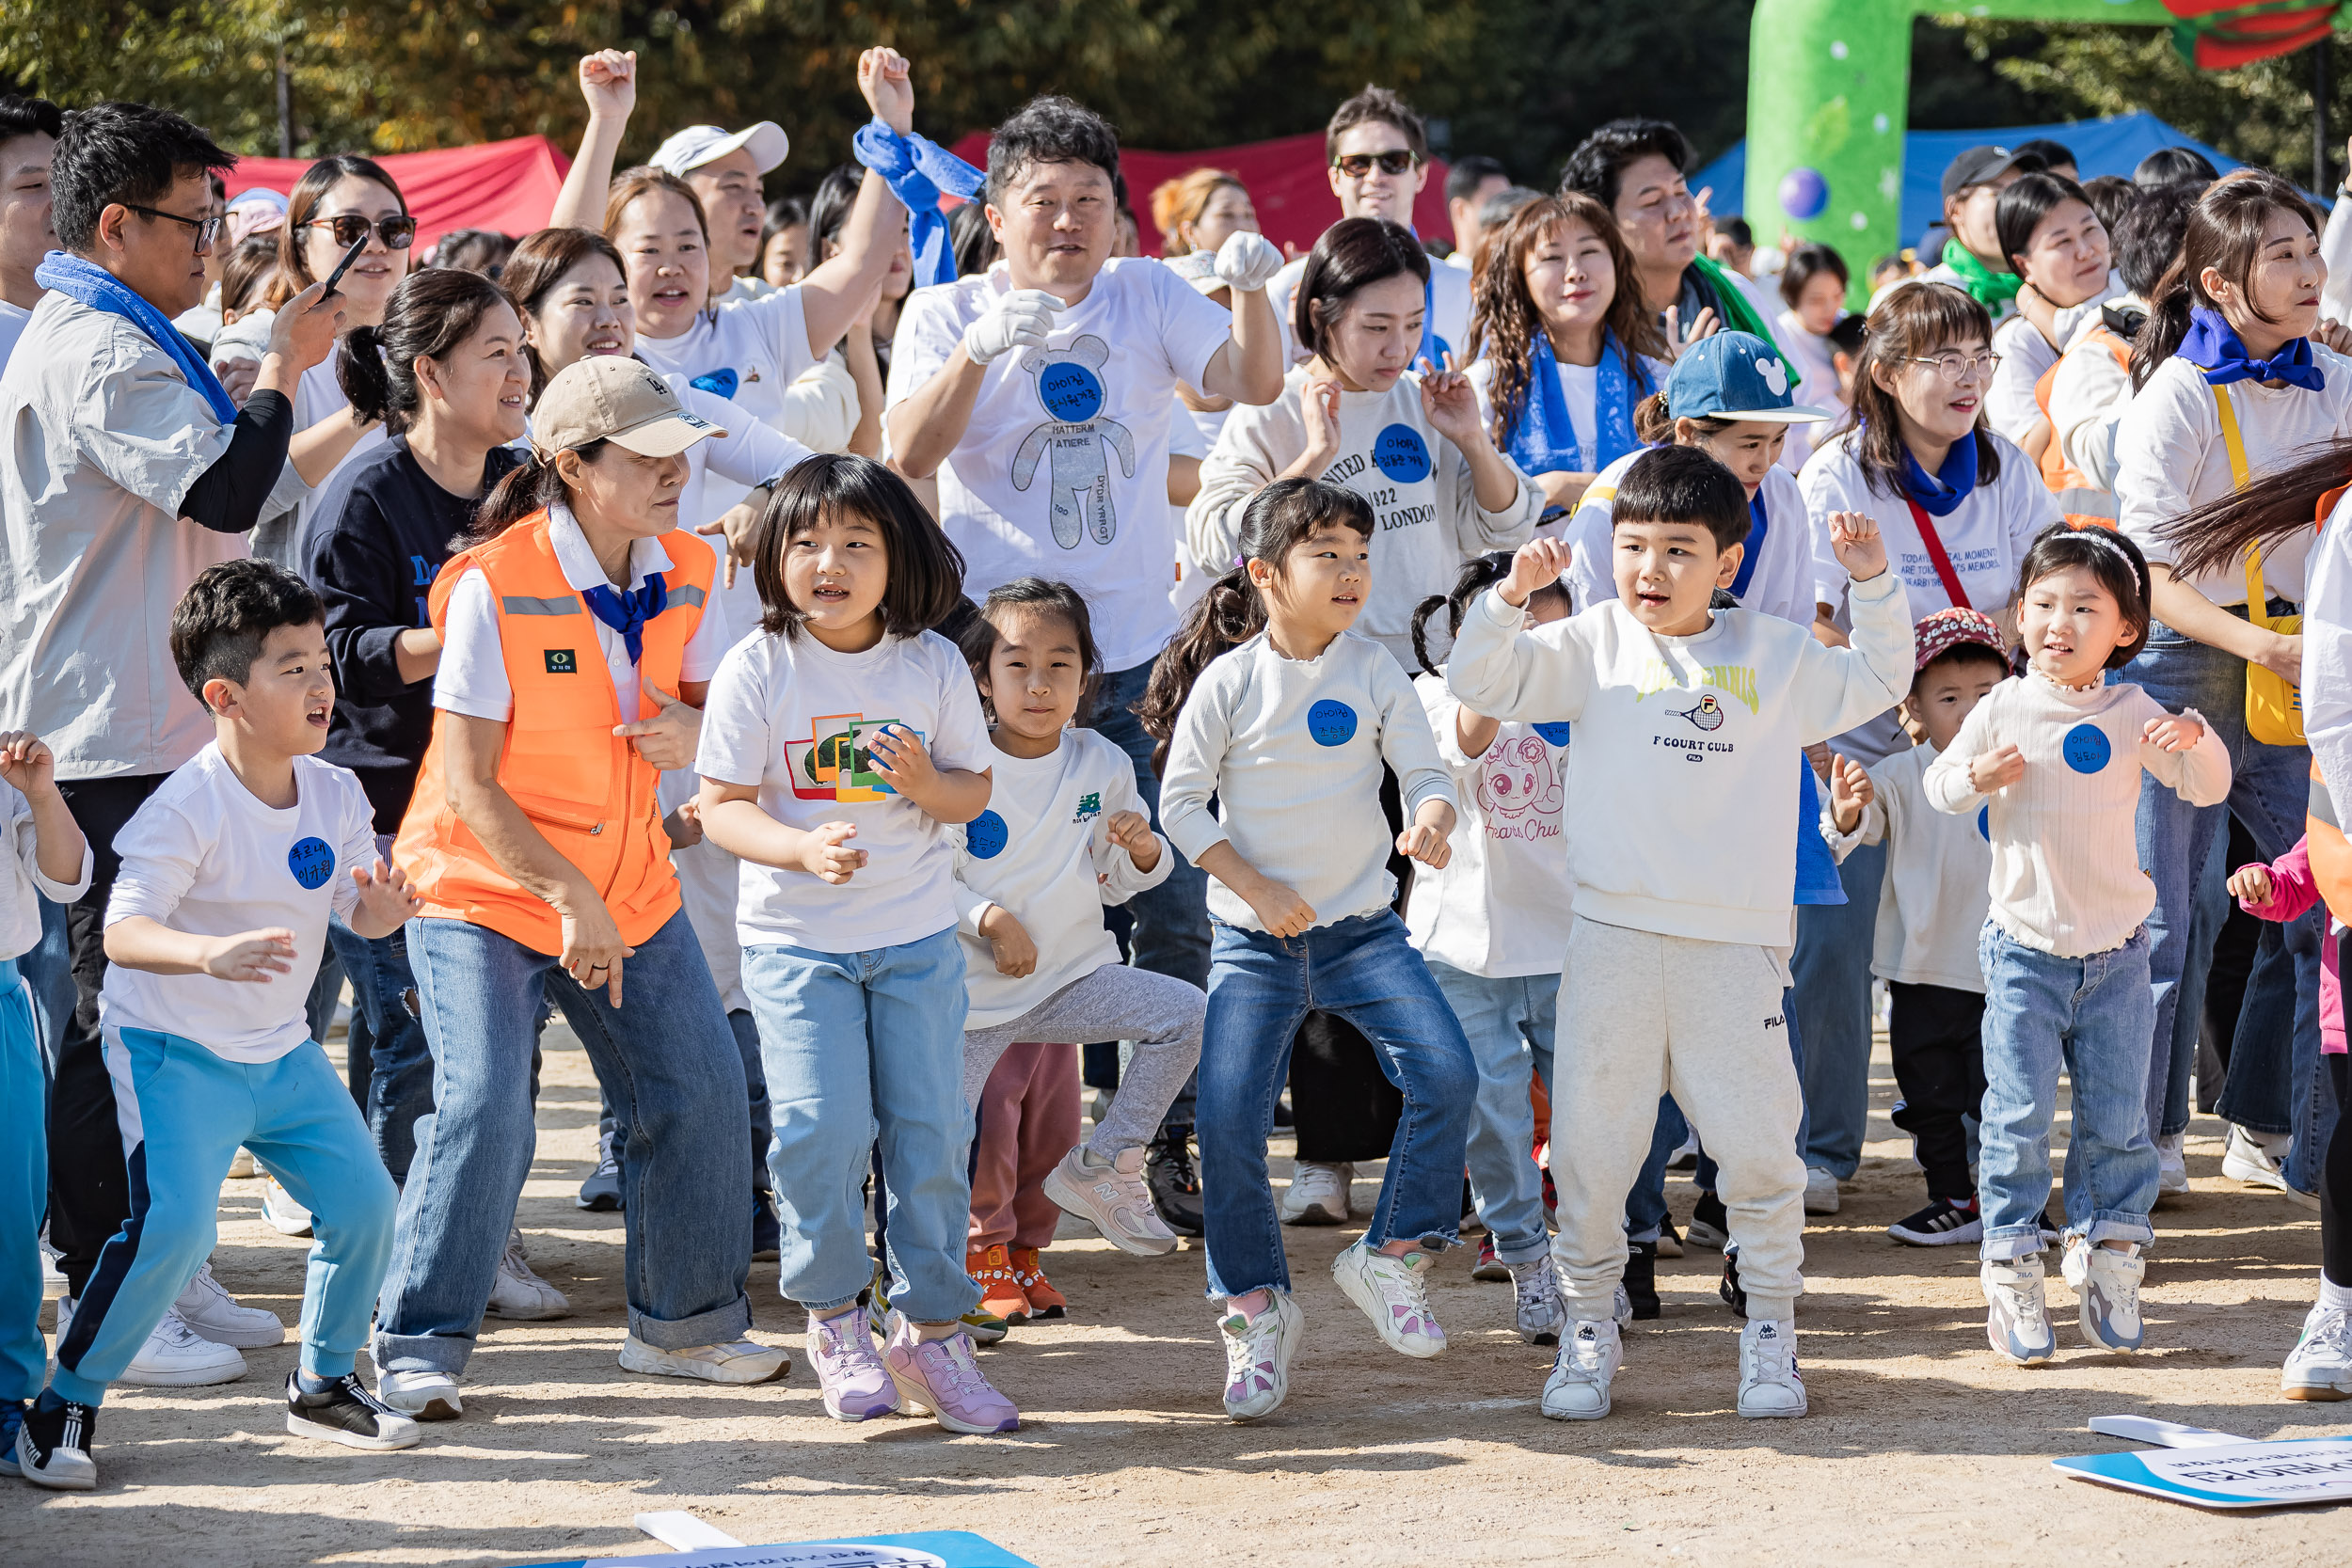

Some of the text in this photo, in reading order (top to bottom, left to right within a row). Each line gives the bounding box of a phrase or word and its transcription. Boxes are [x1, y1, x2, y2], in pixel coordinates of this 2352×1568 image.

[646, 377, 668, 395] LA
[1320, 453, 1366, 484] NITED
[1900, 565, 1915, 575] ARE
[1652, 736, 1735, 753] F COURT CULB
[1524, 818, 1560, 842] Chu
[1763, 1013, 1786, 1031] FILA
[2122, 1260, 2138, 1271] FILA
[2016, 1271, 2033, 1279] FILA
[1758, 1332, 1777, 1340] Kappa
[2177, 1458, 2352, 1483] 어린이집
